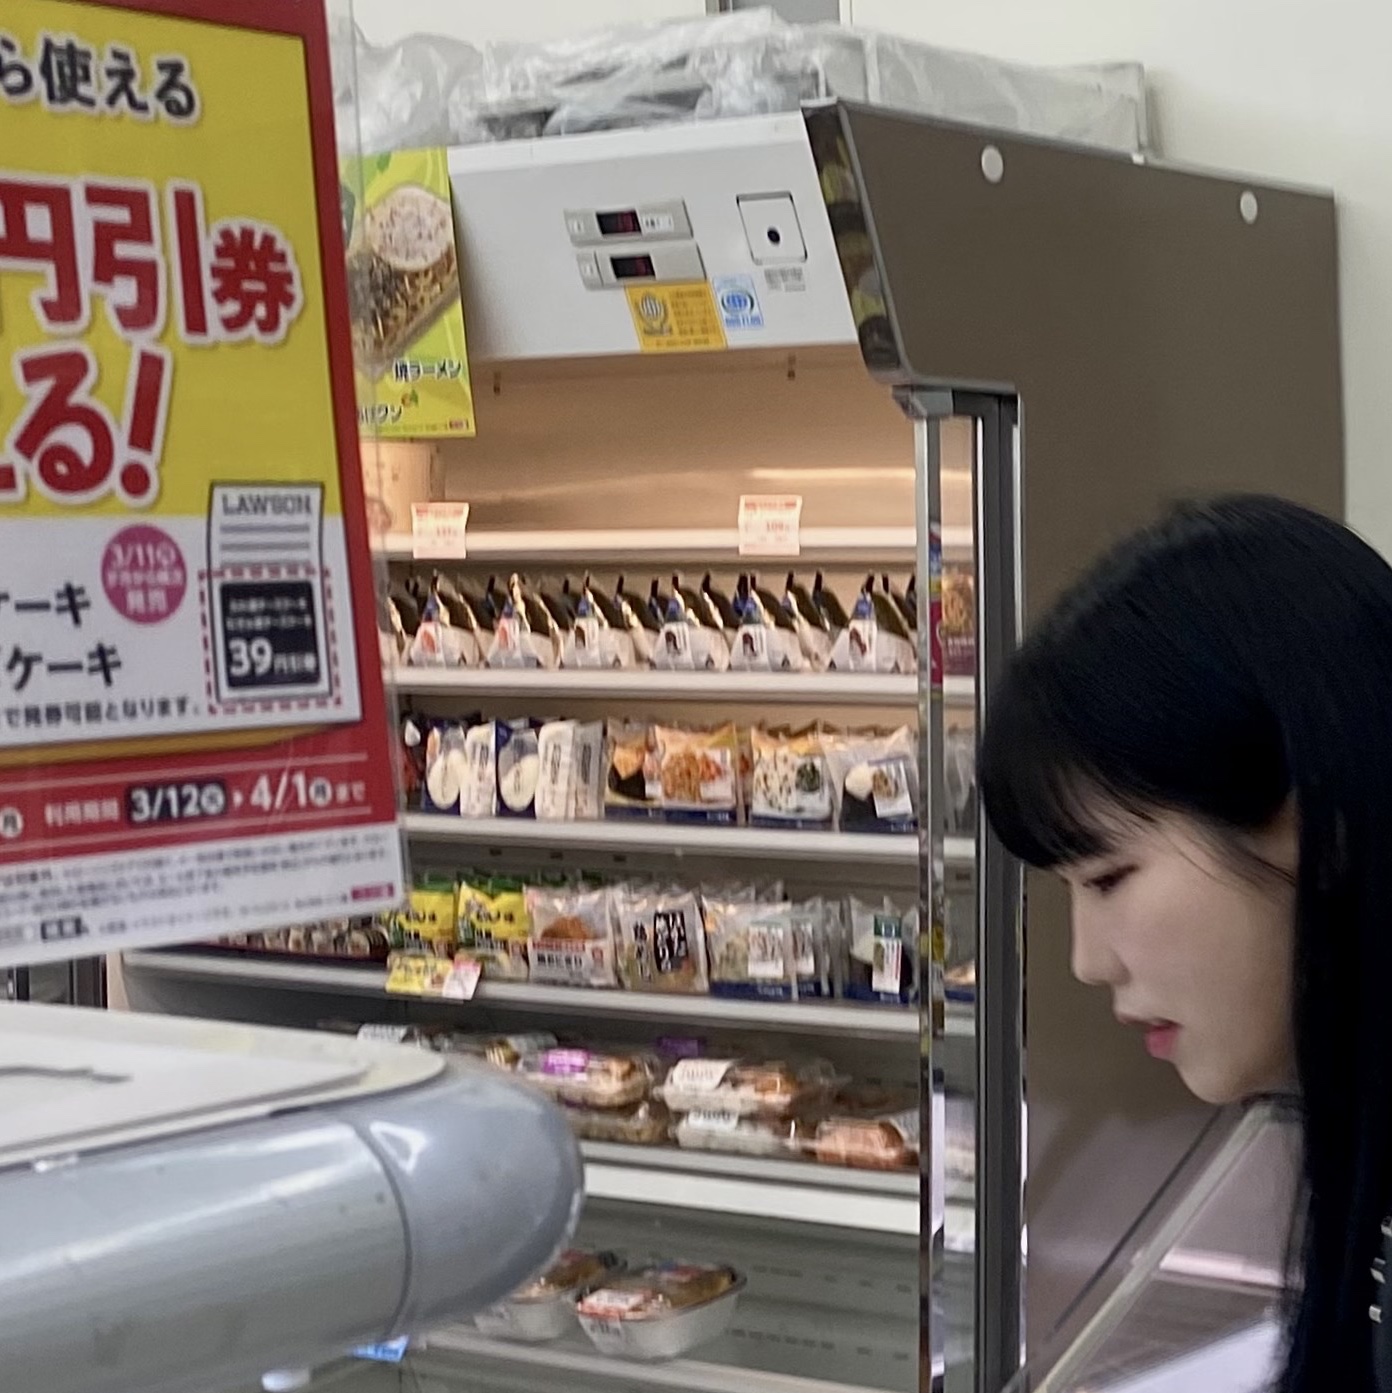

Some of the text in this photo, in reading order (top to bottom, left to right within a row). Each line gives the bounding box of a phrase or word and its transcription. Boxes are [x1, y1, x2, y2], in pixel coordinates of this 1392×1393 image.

[0, 350, 166, 498] る!
[222, 494, 312, 516] LAWSON
[0, 581, 91, 627] ーキ
[6, 643, 122, 692] ケーキ
